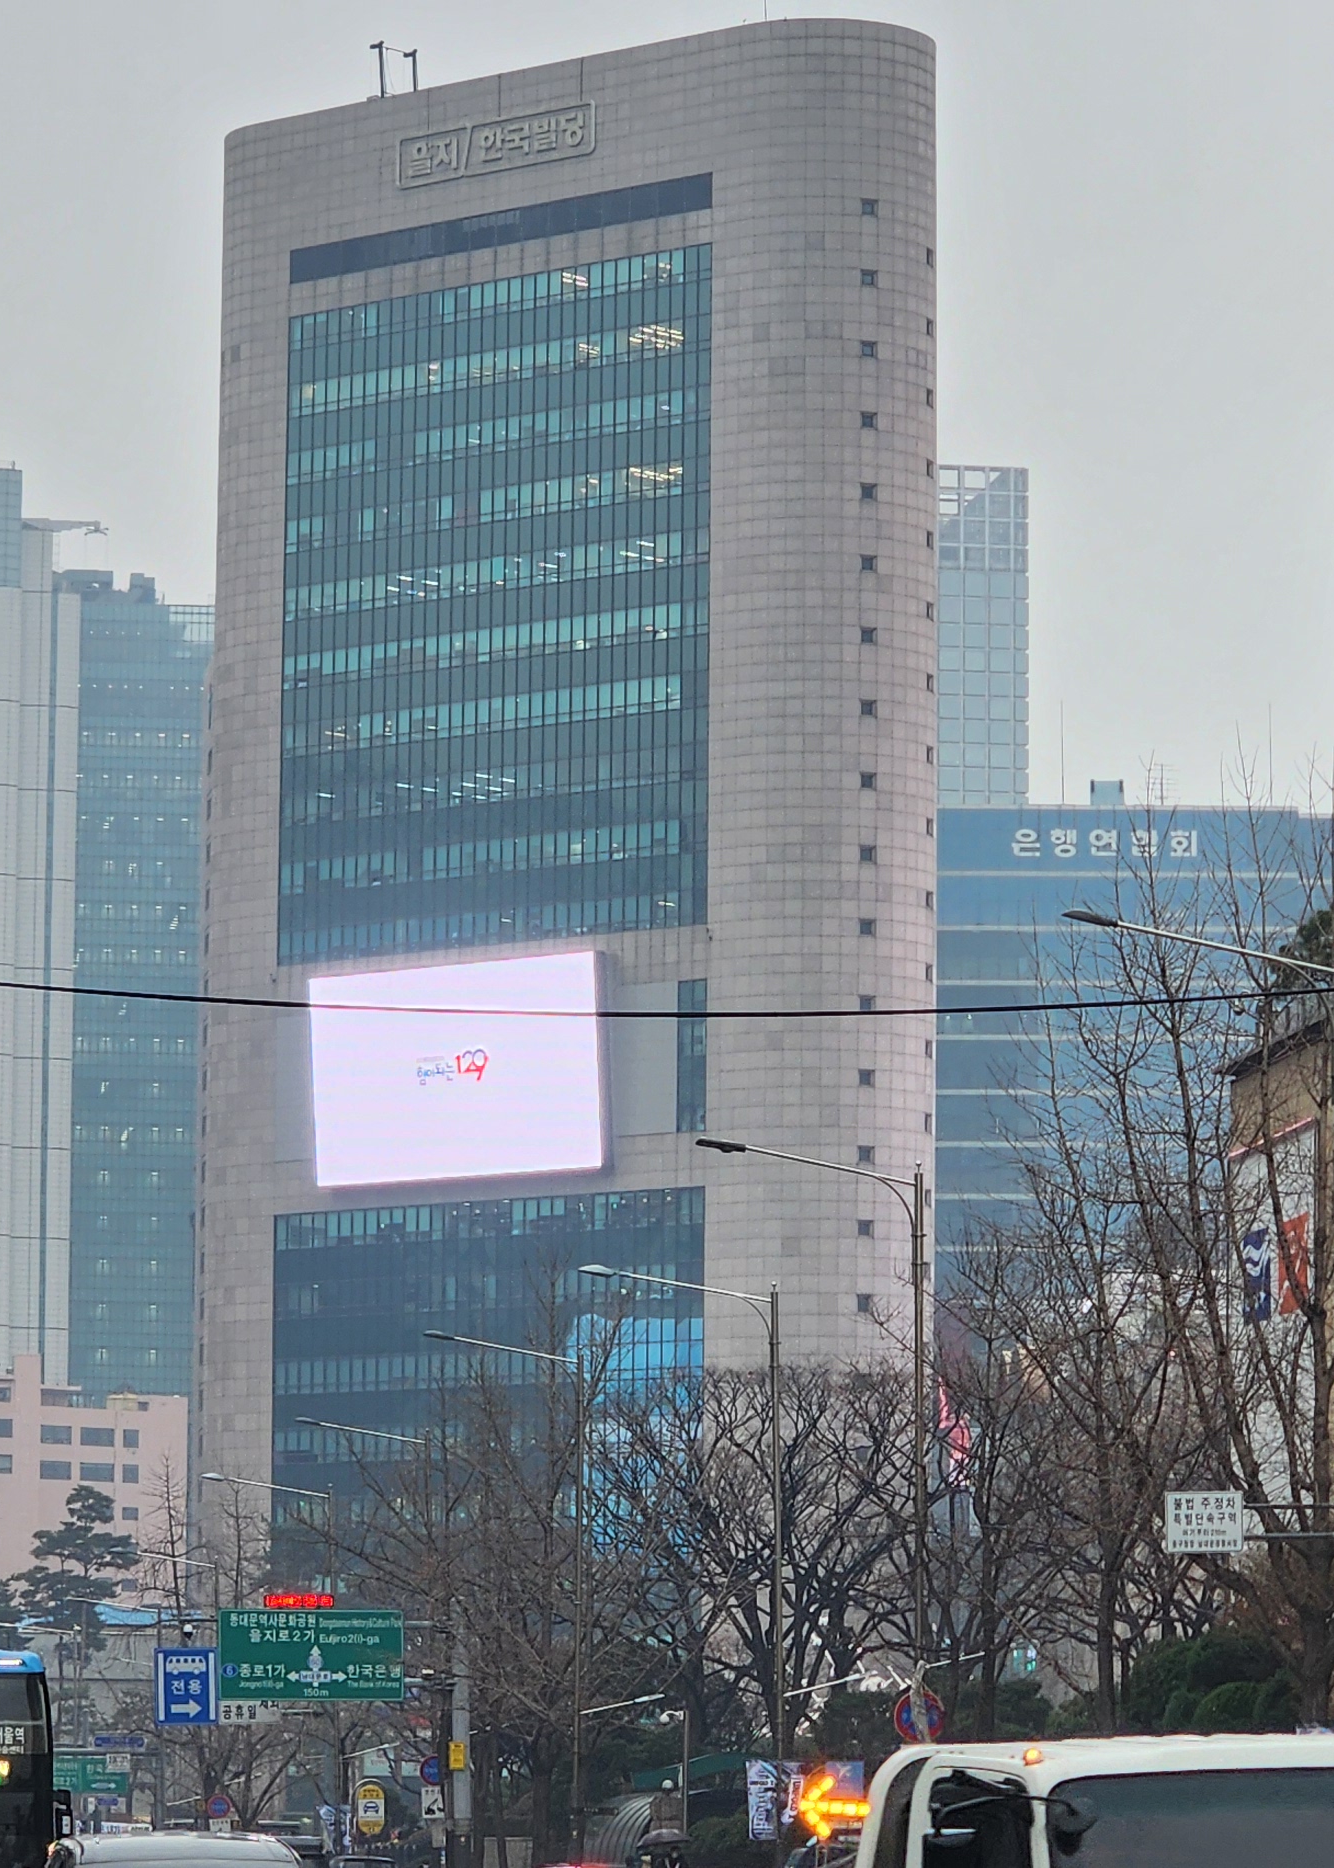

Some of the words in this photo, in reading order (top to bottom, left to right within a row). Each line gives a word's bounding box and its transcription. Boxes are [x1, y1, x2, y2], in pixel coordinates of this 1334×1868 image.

[409, 137, 459, 178] 을지
[482, 111, 586, 162] 한국빌딩
[1011, 828, 1198, 857] 은행연합회
[1174, 1497, 1194, 1511] 불법
[229, 1613, 316, 1627] 동대문역사문화공원
[249, 1629, 315, 1643] 을지로2가
[239, 1663, 285, 1678] 종로1가
[171, 1679, 202, 1695] 전용
[222, 1704, 256, 1719] 공휴일
